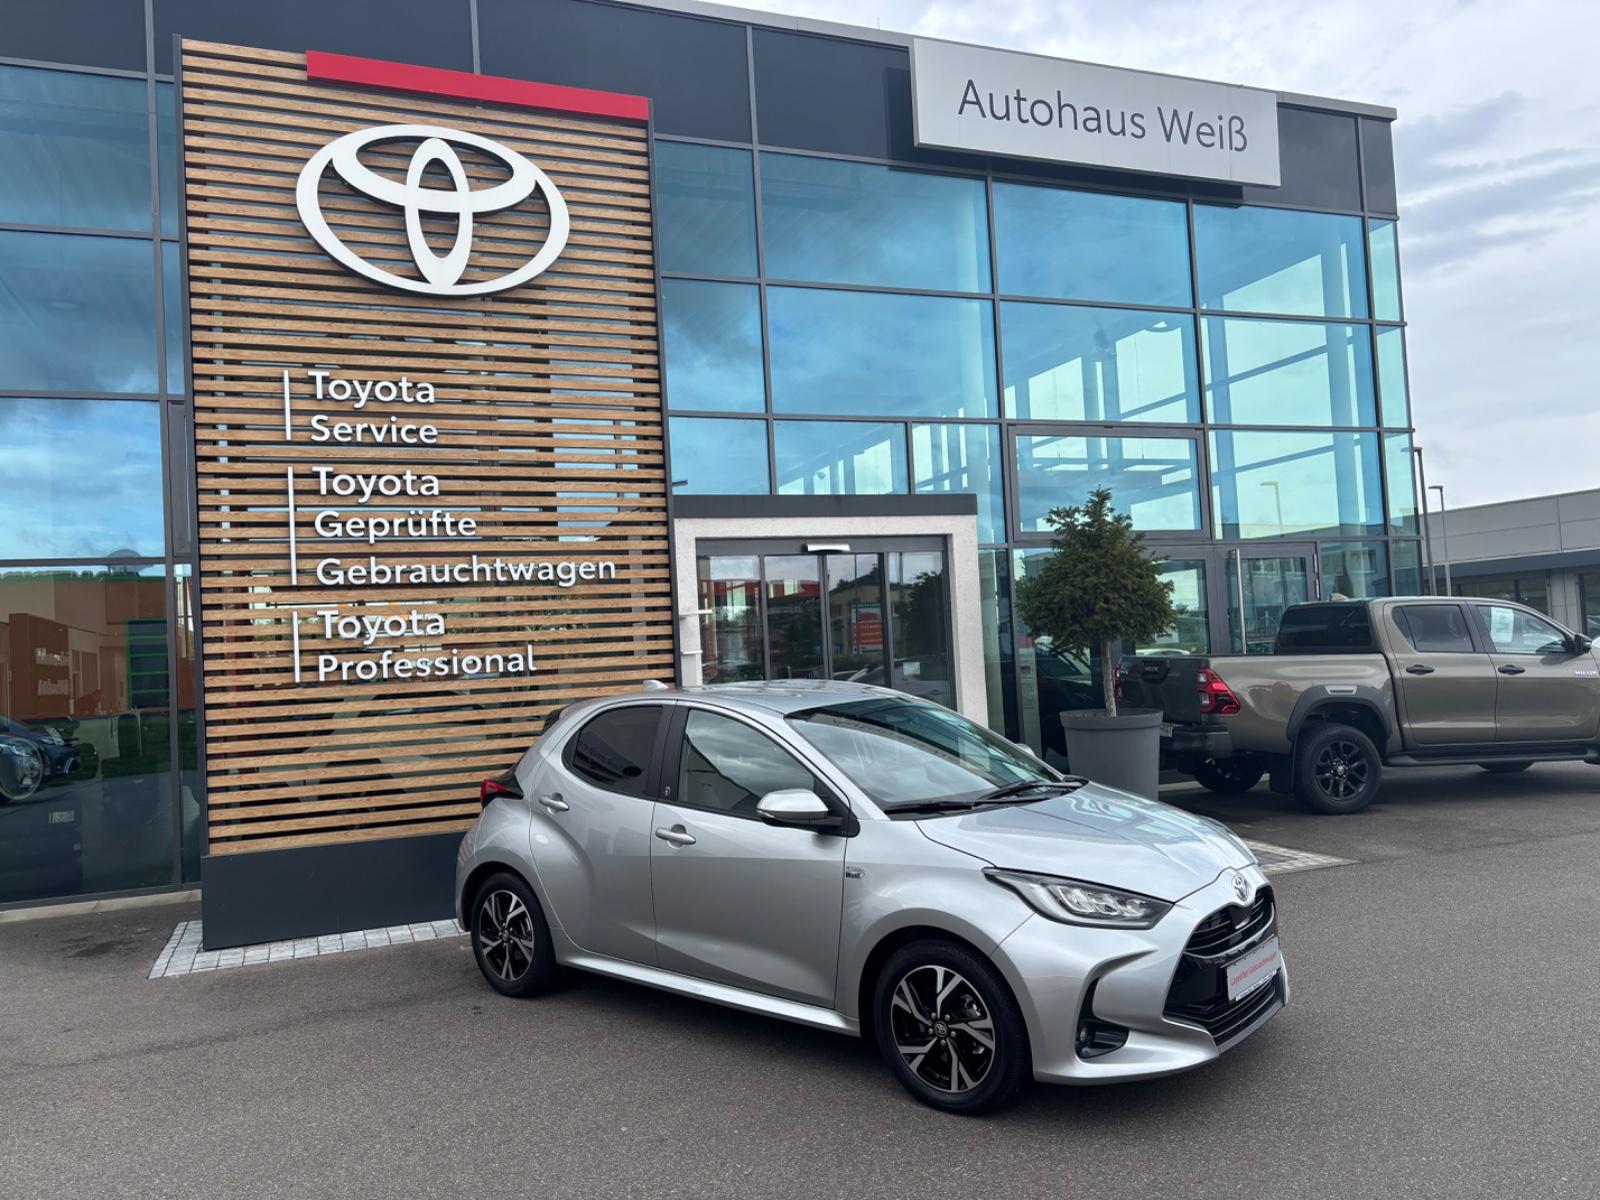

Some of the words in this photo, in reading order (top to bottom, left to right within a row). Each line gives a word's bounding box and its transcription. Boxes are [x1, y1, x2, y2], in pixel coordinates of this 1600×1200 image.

[958, 78, 1147, 140] Autohaus
[1156, 104, 1248, 153] Weiß
[307, 370, 436, 409] Toyota
[310, 415, 439, 445] Service
[311, 465, 440, 504] Toyota
[314, 510, 478, 545] Geprüfte
[315, 554, 617, 588] Gebrauchtwagen
[316, 608, 447, 647] Toyota
[318, 644, 538, 683] Professional
